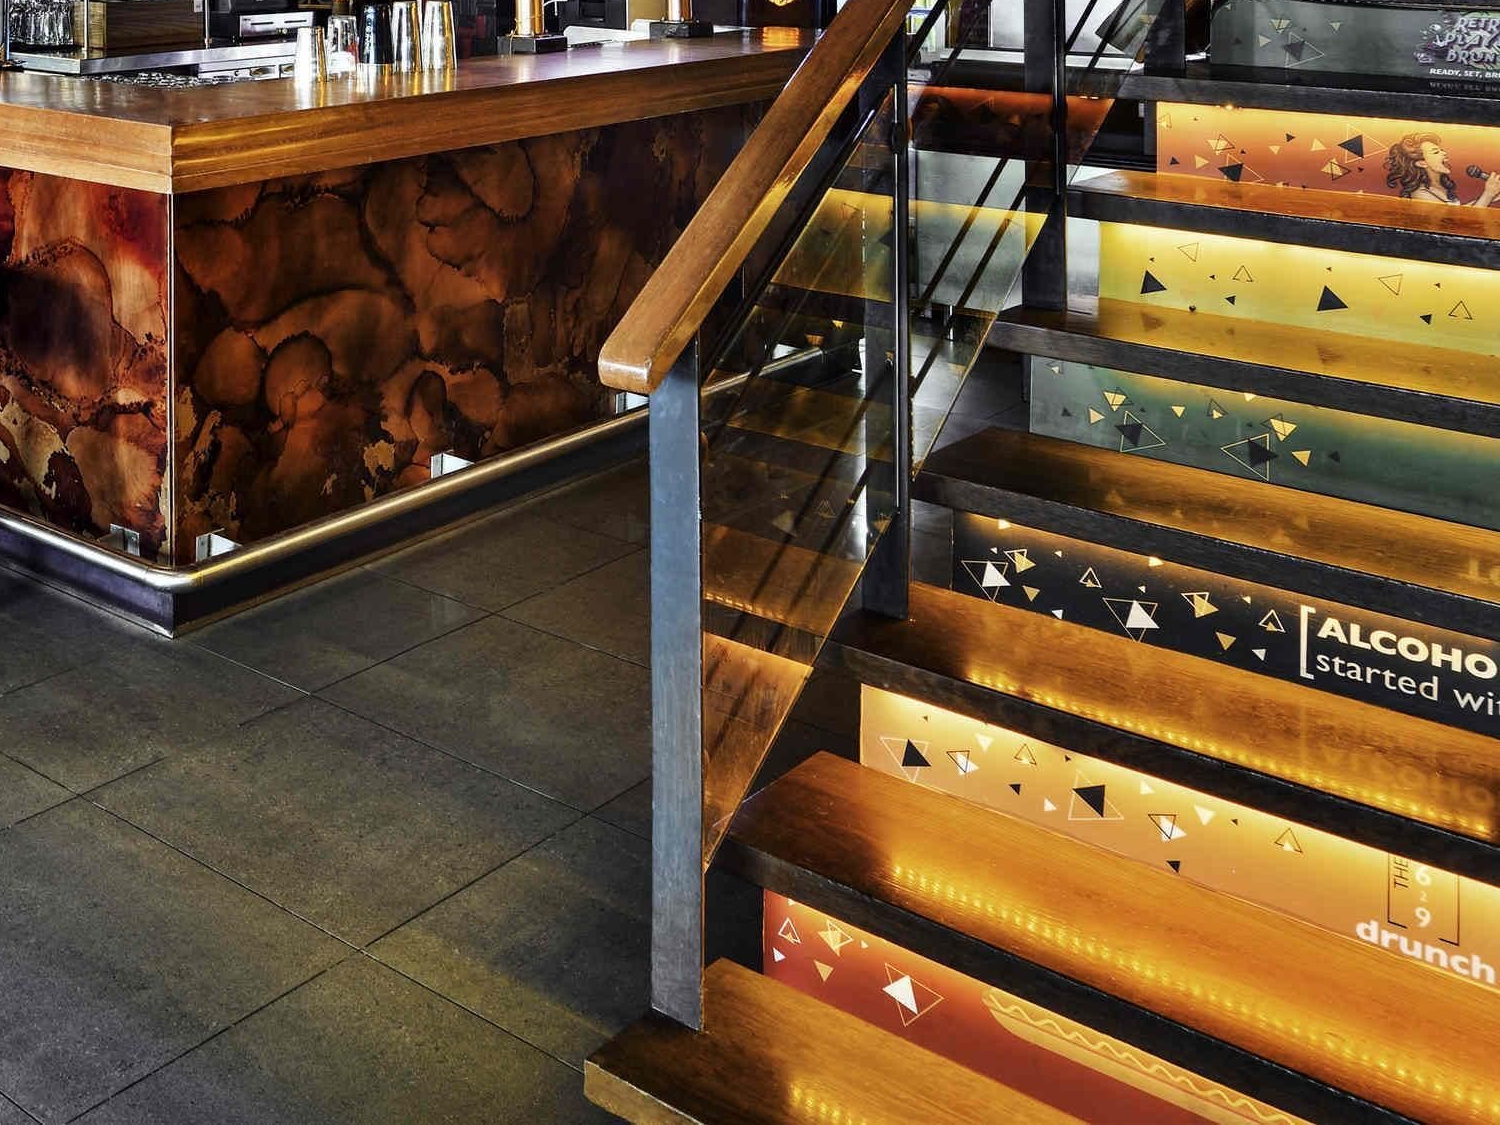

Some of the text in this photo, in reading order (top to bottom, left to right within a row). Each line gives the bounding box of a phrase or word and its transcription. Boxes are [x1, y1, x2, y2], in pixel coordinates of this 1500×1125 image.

[1446, 49, 1500, 65] BRUN
[1429, 68, 1461, 77] READY,
[1464, 70, 1483, 78] SET,
[1317, 617, 1498, 679] ALCOHO
[1316, 654, 1438, 701] started
[1415, 866, 1431, 886] 6
[1415, 907, 1431, 927] 9
[1355, 920, 1496, 985] drunch
